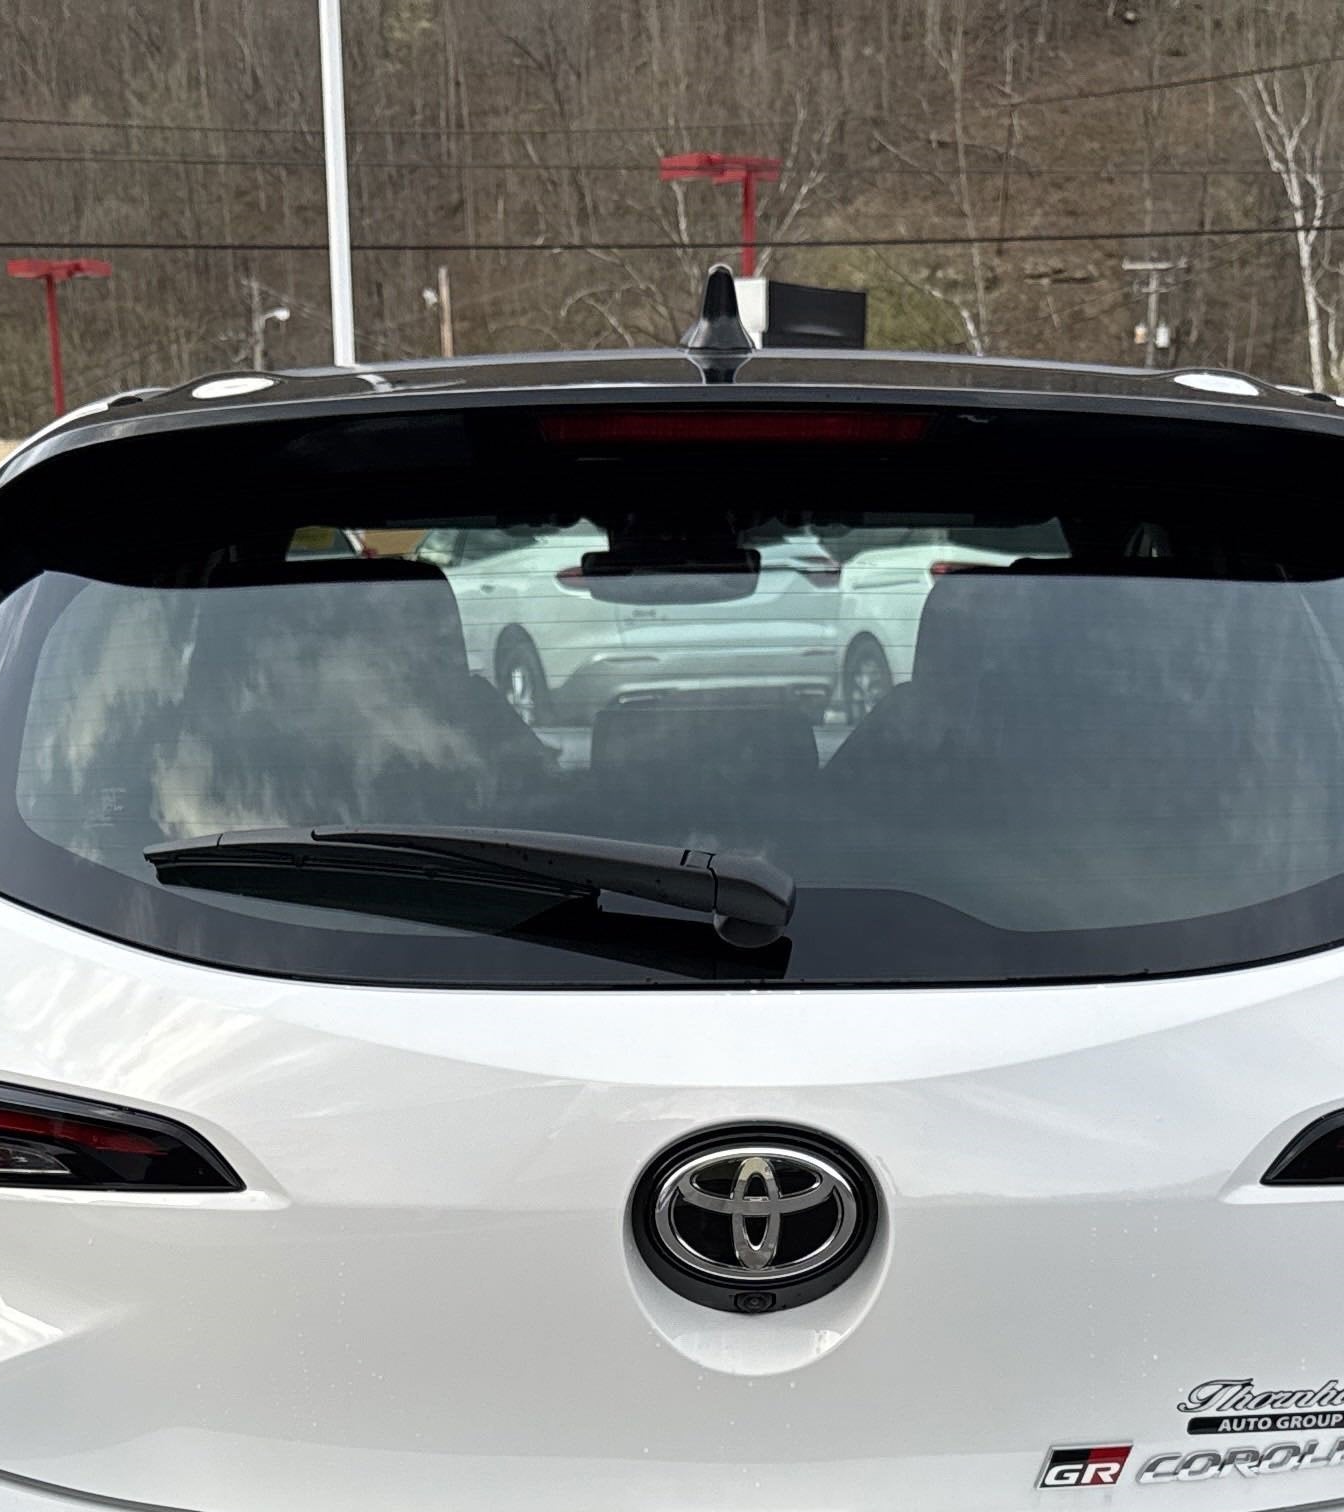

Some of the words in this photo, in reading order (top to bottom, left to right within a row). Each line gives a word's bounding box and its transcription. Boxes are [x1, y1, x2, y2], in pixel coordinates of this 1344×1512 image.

[1217, 1416, 1272, 1432] AUTO
[1276, 1413, 1344, 1430] GROUP
[1043, 1461, 1121, 1486] GR
